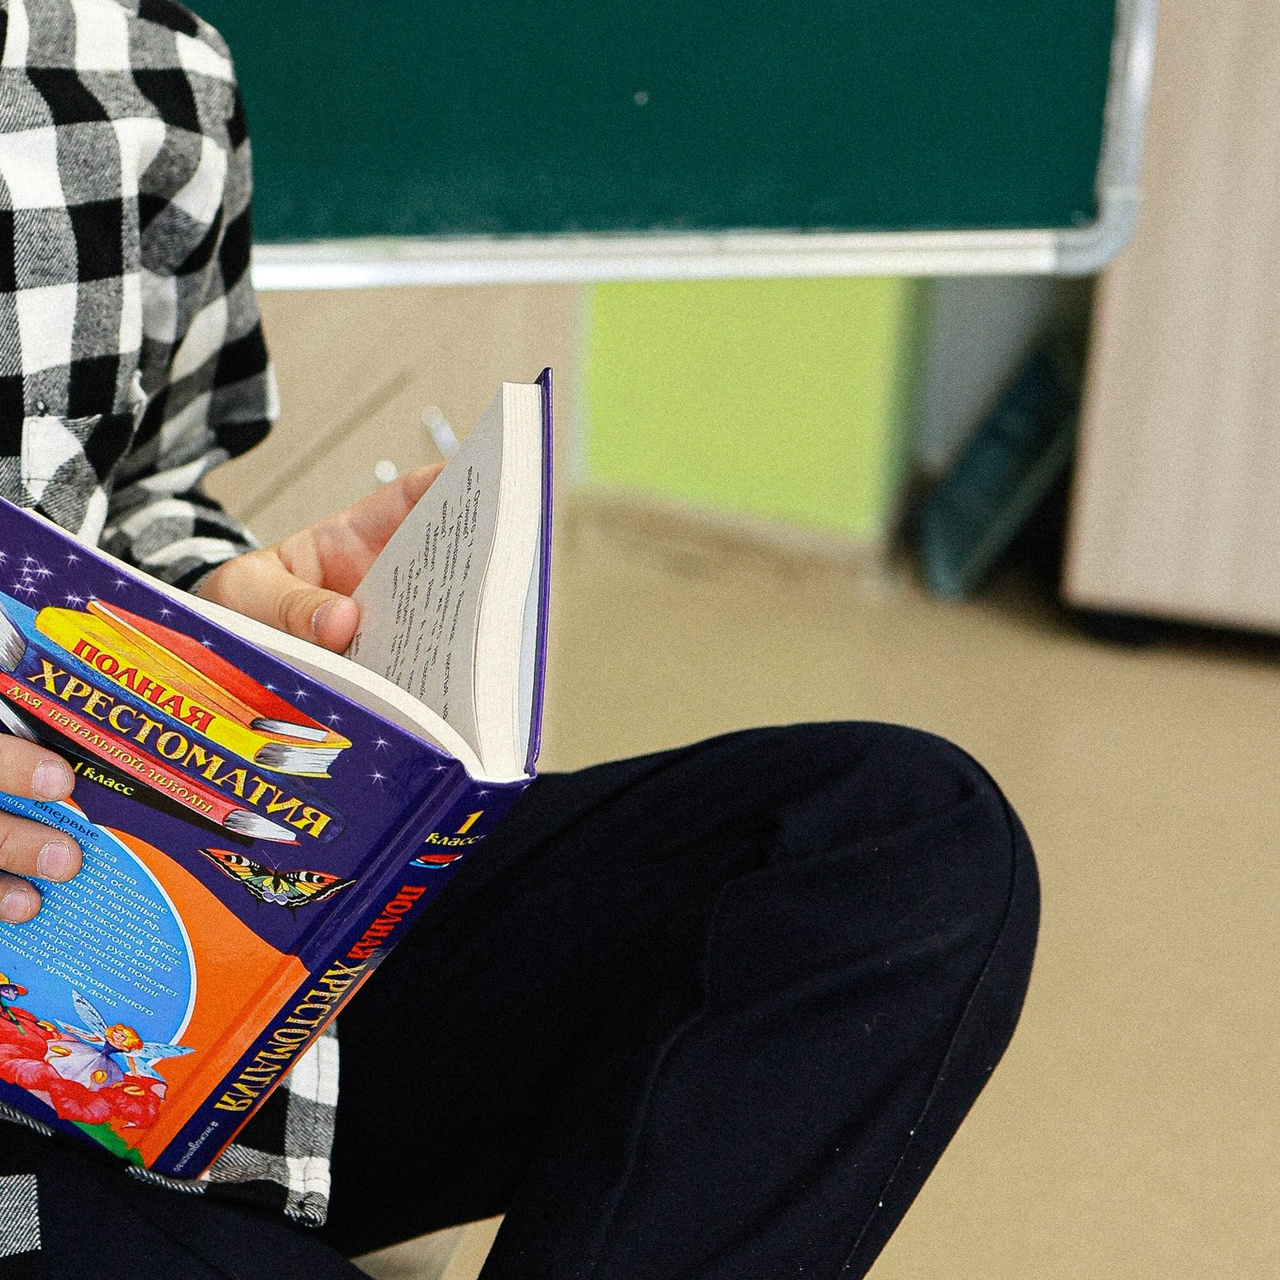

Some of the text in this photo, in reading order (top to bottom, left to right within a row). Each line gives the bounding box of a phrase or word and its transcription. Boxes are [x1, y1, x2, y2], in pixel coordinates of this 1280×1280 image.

[70, 636, 216, 735] ПОЛНАЯ
[5, 682, 213, 814] для начальной школы
[26, 657, 332, 840] ХРЕСТОМАТИЯ
[71, 760, 135, 797] 1 класс
[2, 794, 25, 811] для
[77, 836, 118, 863] класса
[32, 798, 100, 842] Впервые
[454, 809, 478, 835] 1
[49, 889, 144, 946] первоклассника.
[149, 944, 159, 954] В
[160, 952, 182, 967] нее
[80, 896, 124, 924] учтены
[125, 920, 182, 956] интересы
[95, 893, 104, 902] и
[106, 899, 140, 923] науки
[141, 917, 163, 934] РФ.
[109, 878, 168, 915] основные
[17, 927, 94, 973] его кругозор.
[28, 922, 75, 952] интерес
[77, 949, 85, 957] к
[87, 955, 131, 983] чтению
[133, 980, 160, 999] книг
[52, 924, 125, 969] хрестоматия
[126, 965, 180, 999] поможет
[64, 908, 77, 920] из
[81, 918, 132, 950] золотого
[133, 947, 173, 973] фонда
[105, 942, 153, 973] русской
[29, 944, 50, 959] для
[51, 956, 154, 1017] самостоятельного
[35, 958, 44, 966] к
[44, 963, 86, 990] урокам
[87, 987, 120, 1009] дома.
[212, 882, 428, 1114] ПОЛНАЯ ХРЕСТОМАТИЯ
